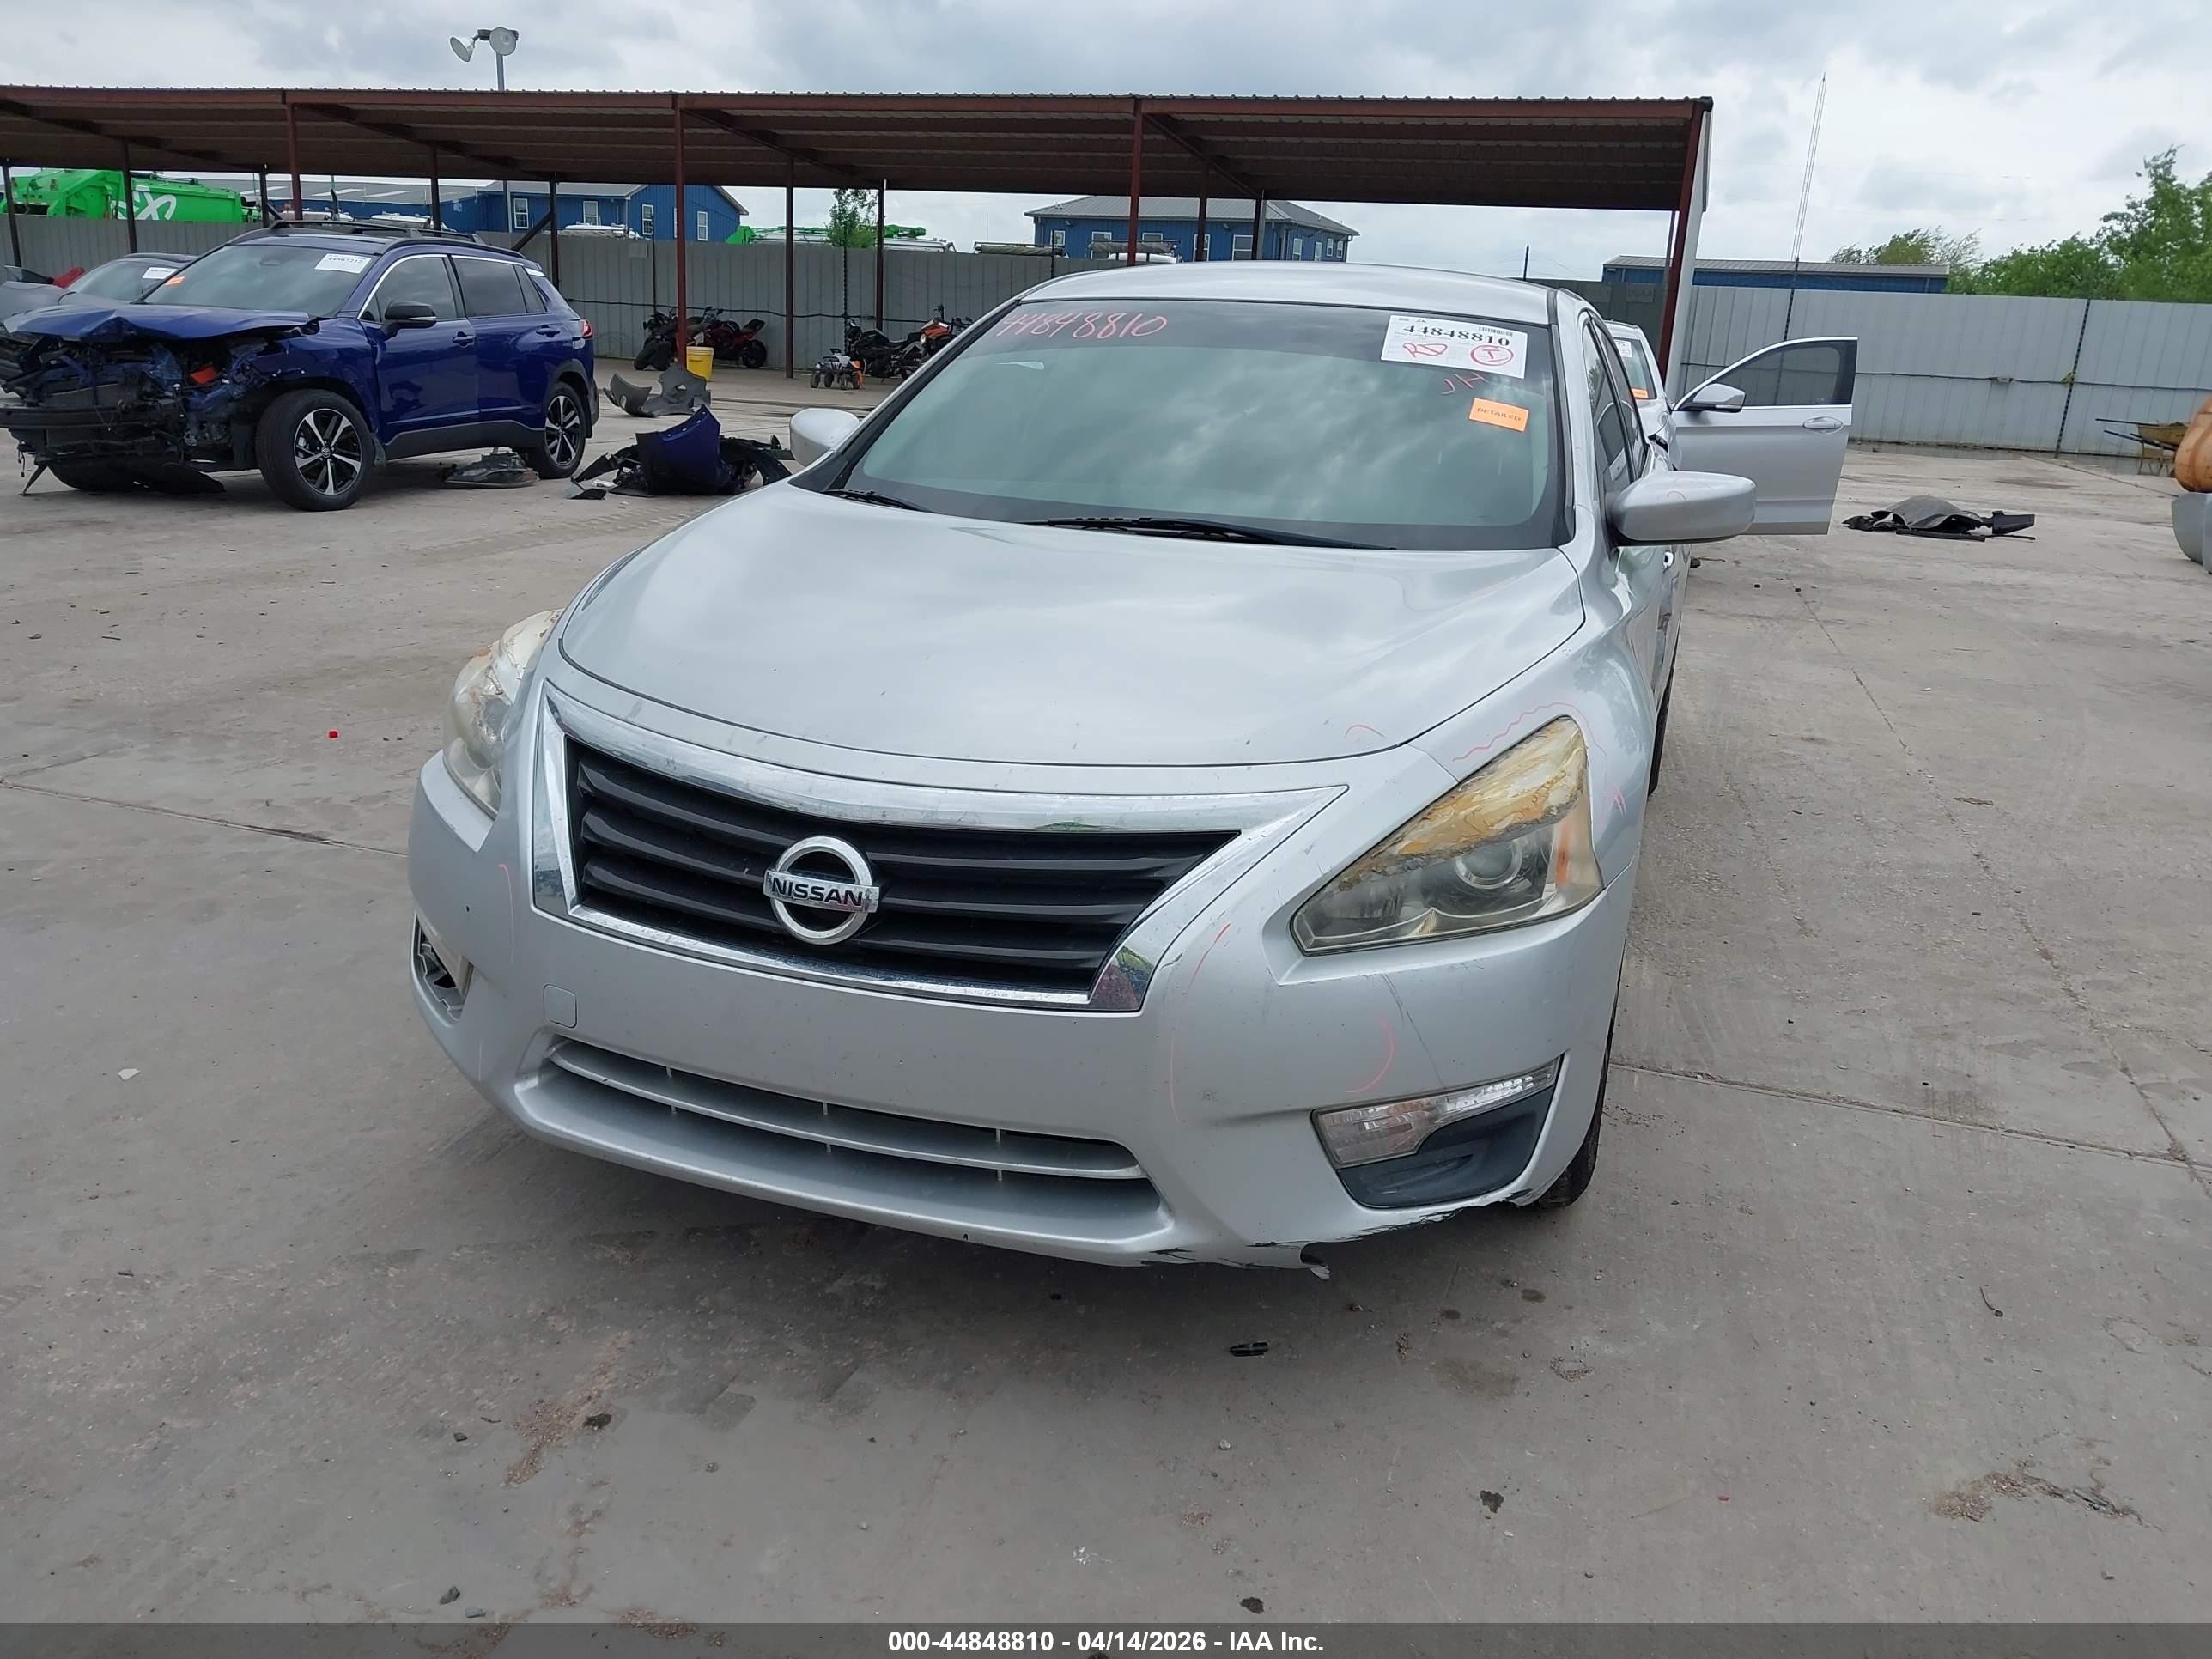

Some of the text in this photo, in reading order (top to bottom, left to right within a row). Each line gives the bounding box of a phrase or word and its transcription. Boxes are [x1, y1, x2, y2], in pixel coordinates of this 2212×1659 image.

[996, 312, 1168, 339] 44848810
[1403, 325, 1510, 346] 44848810
[1476, 407, 1522, 422] DETAILED
[771, 878, 863, 907] NISSAN
